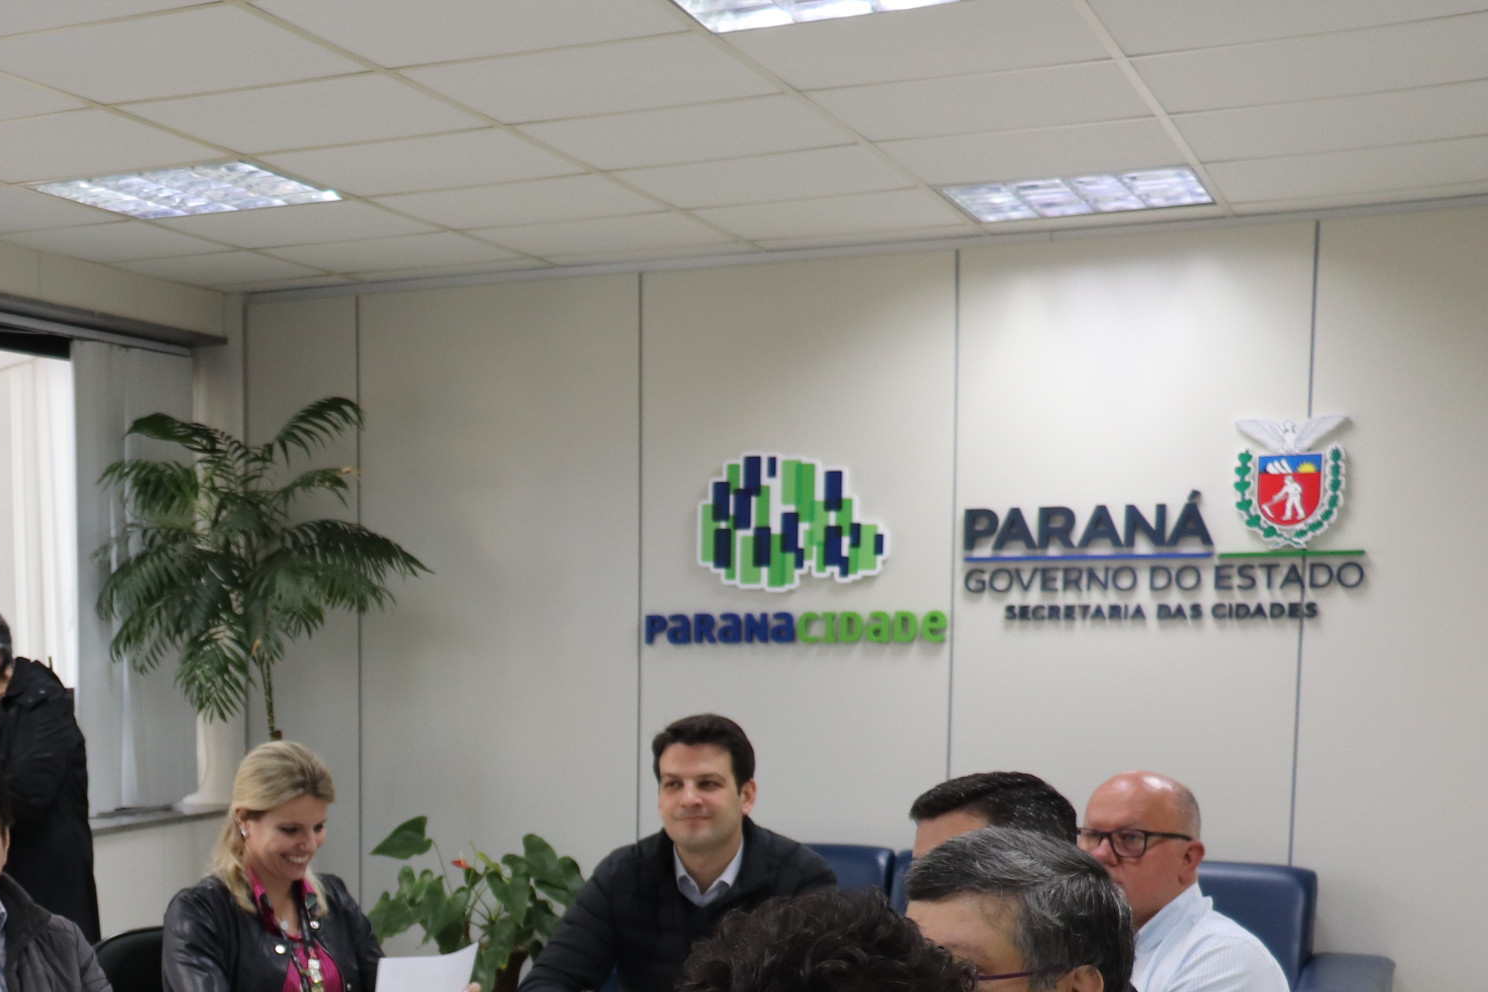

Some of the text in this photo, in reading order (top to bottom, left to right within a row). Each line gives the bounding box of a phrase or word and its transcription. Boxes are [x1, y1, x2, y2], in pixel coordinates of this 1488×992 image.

[964, 490, 1215, 550] PARANÁ
[964, 560, 1365, 593] GOVERNO DO ESTADO
[1004, 602, 1318, 621] SECRETARIA DAS CIDADES
